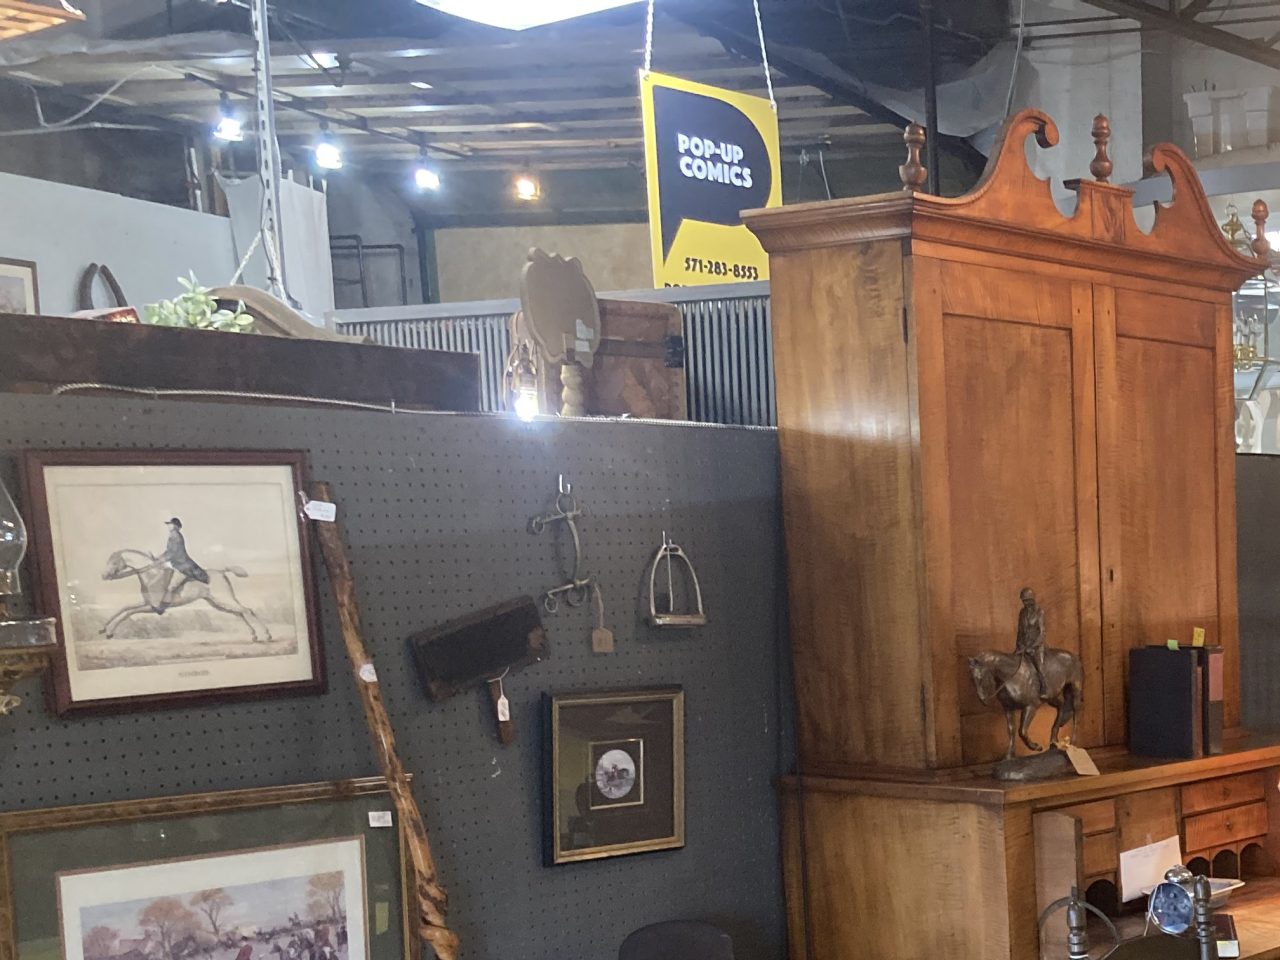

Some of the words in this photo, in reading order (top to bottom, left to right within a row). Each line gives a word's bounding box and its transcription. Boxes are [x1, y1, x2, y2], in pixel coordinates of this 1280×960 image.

[677, 133, 744, 164] POP-UP
[679, 156, 753, 188] COMICS
[684, 257, 759, 280] 571-283-8553
